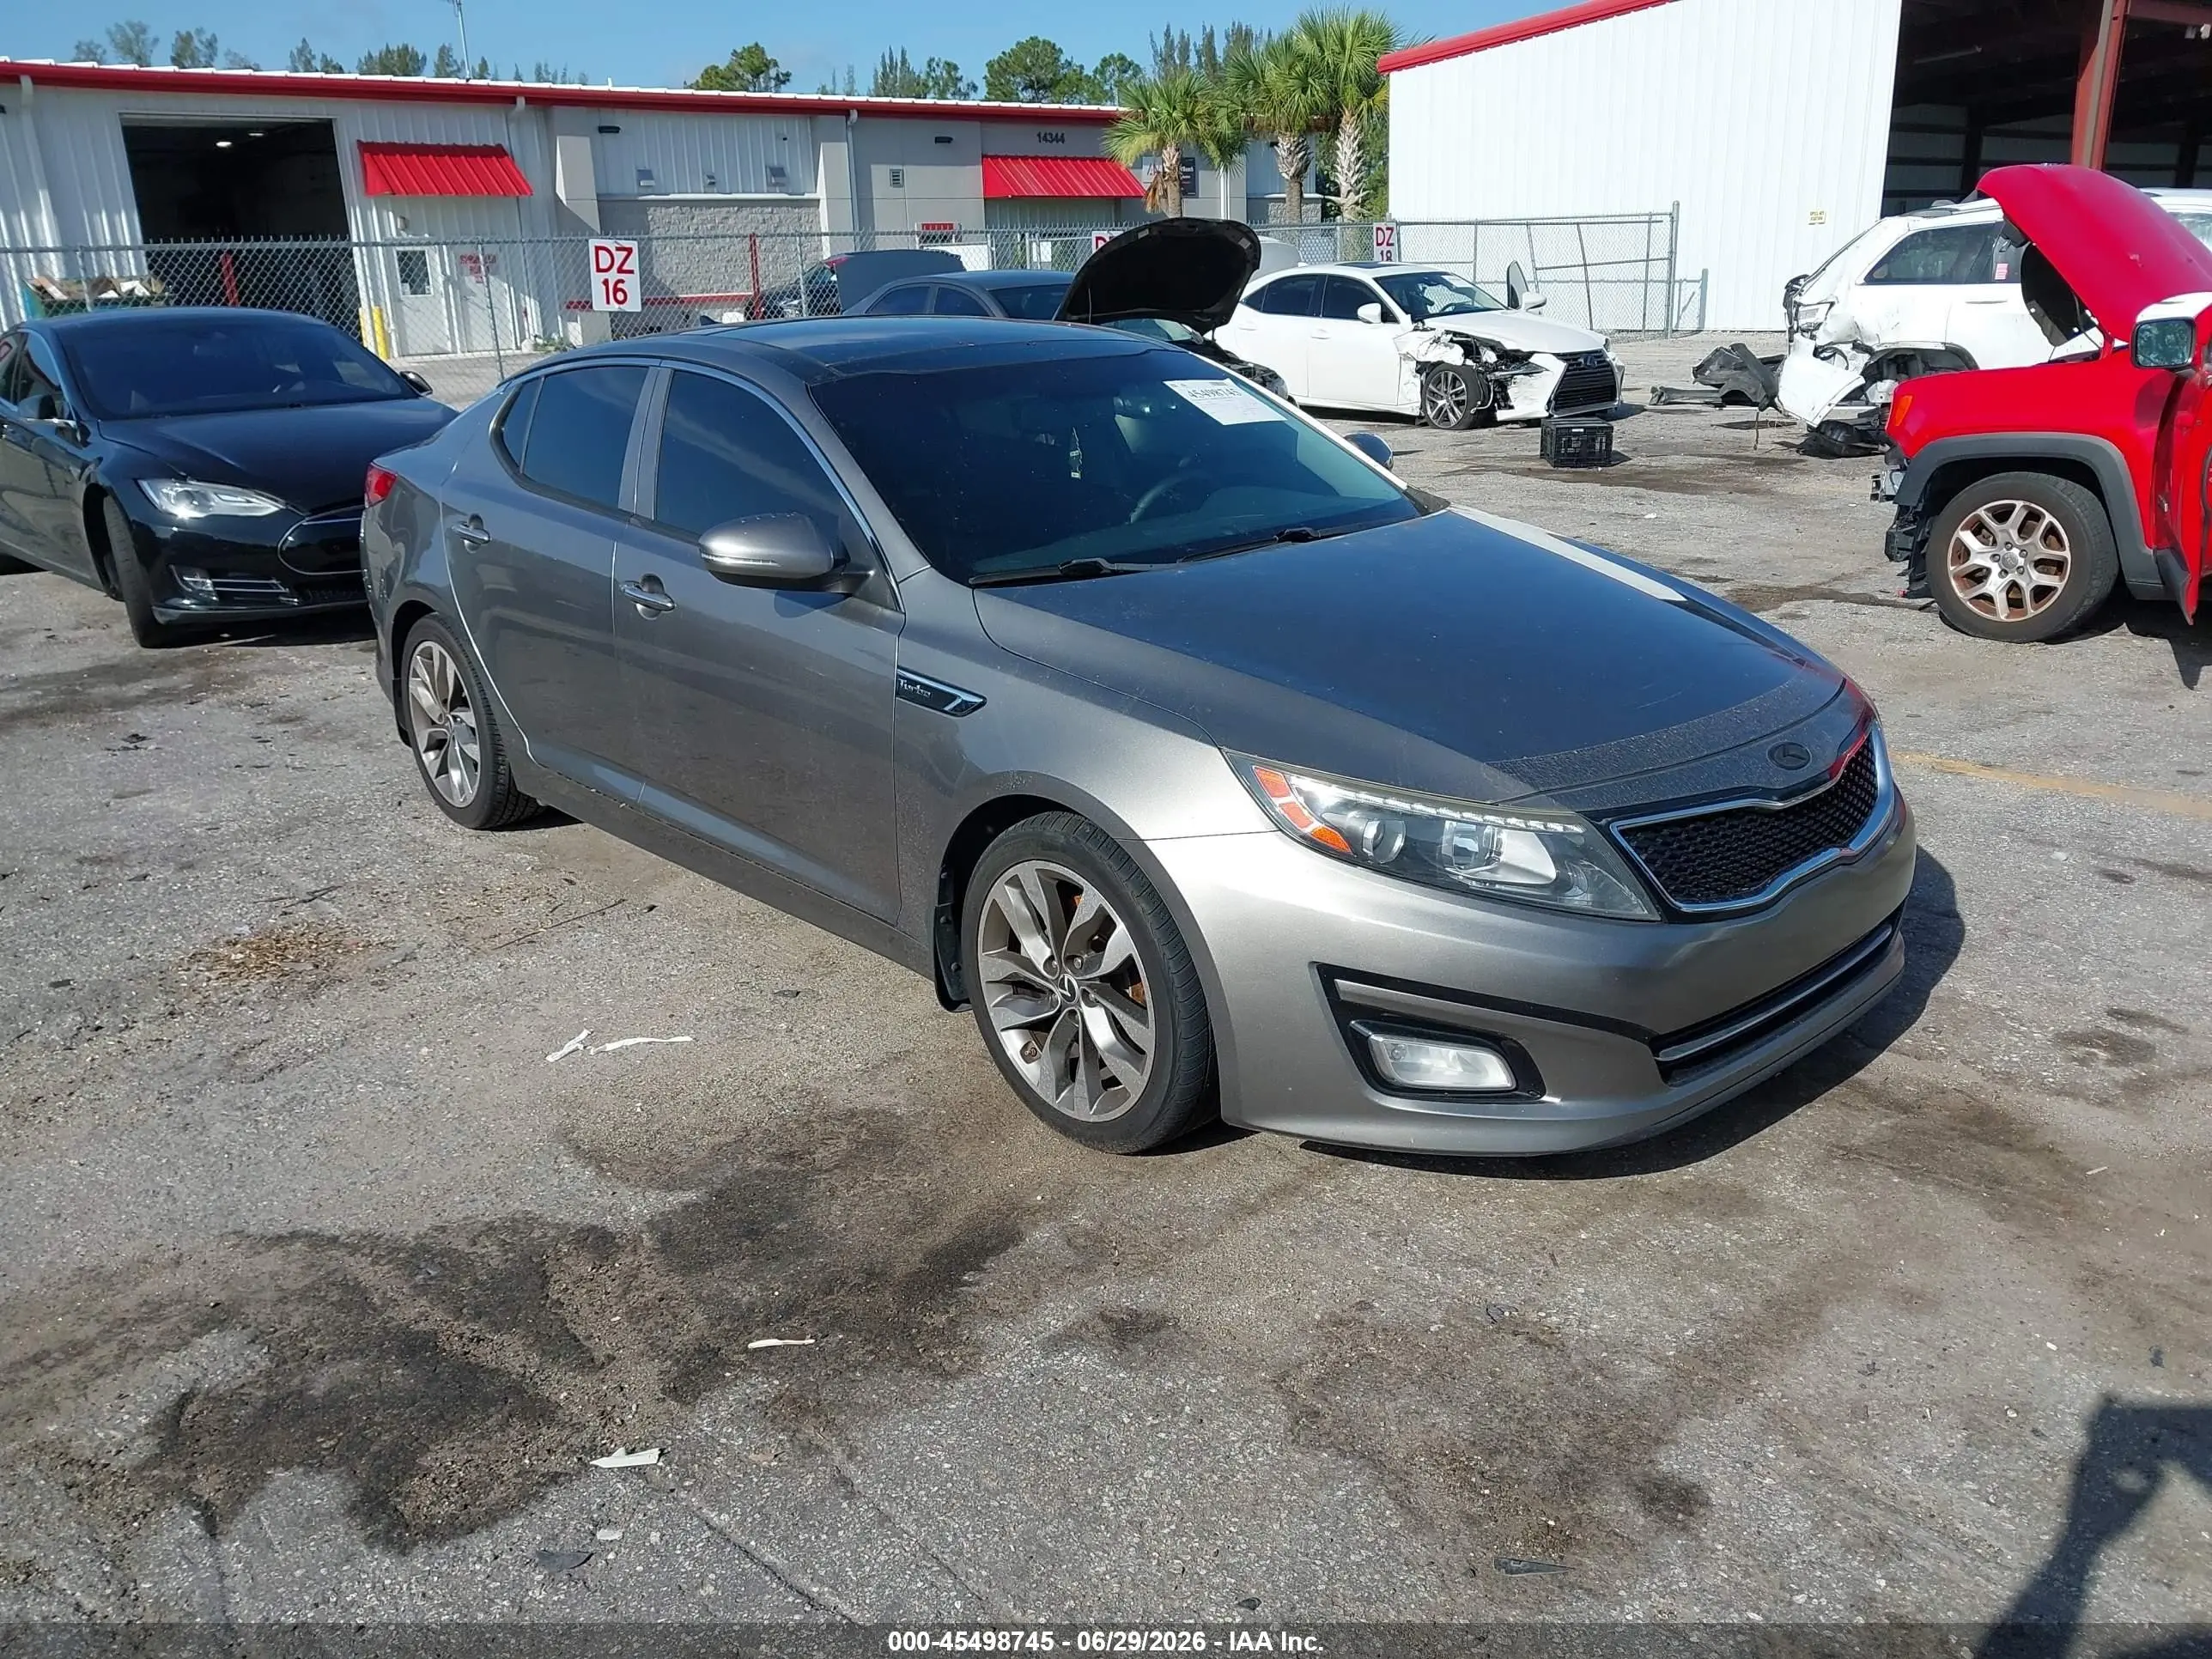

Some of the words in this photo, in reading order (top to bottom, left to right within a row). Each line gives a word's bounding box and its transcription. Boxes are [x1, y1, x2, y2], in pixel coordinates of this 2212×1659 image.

[1036, 131, 1065, 144] 14344
[1376, 227, 1395, 246] DZ
[594, 246, 635, 274] DZ
[602, 278, 628, 305] 16
